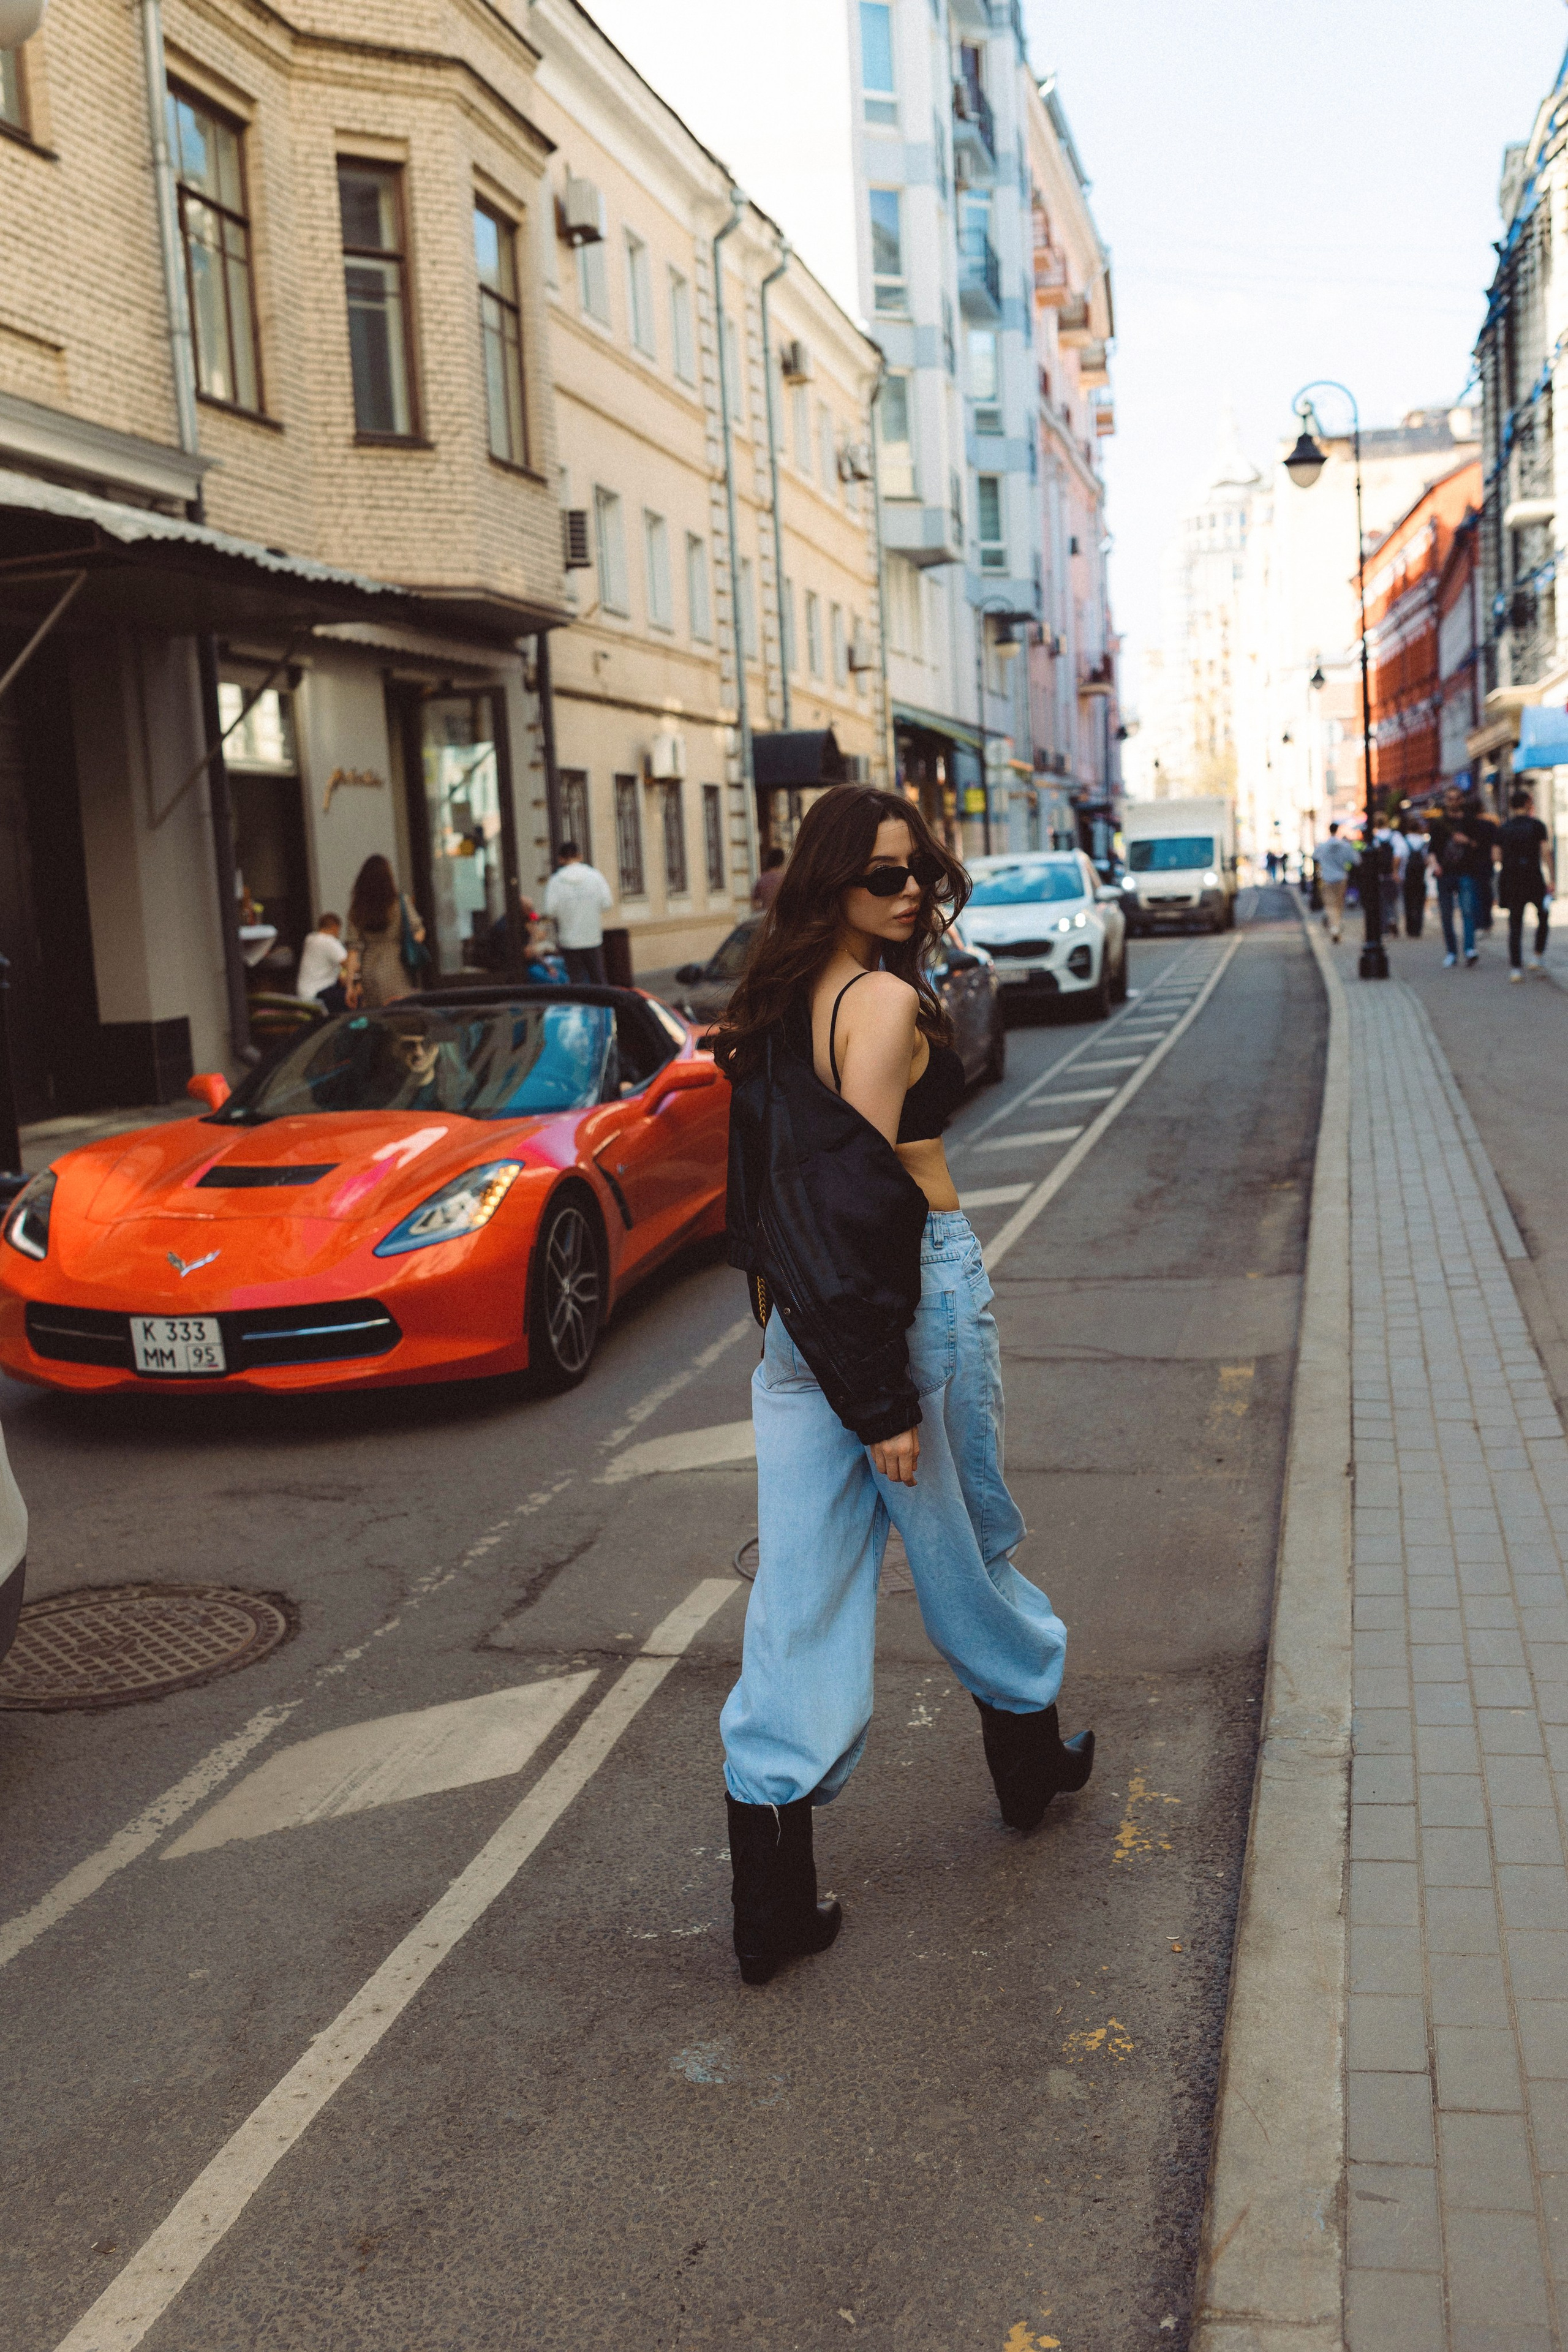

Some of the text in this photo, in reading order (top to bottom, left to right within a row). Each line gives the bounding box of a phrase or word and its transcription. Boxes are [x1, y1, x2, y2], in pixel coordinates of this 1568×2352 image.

[143, 1321, 205, 1341] K 333
[144, 1348, 215, 1368] MM 95
